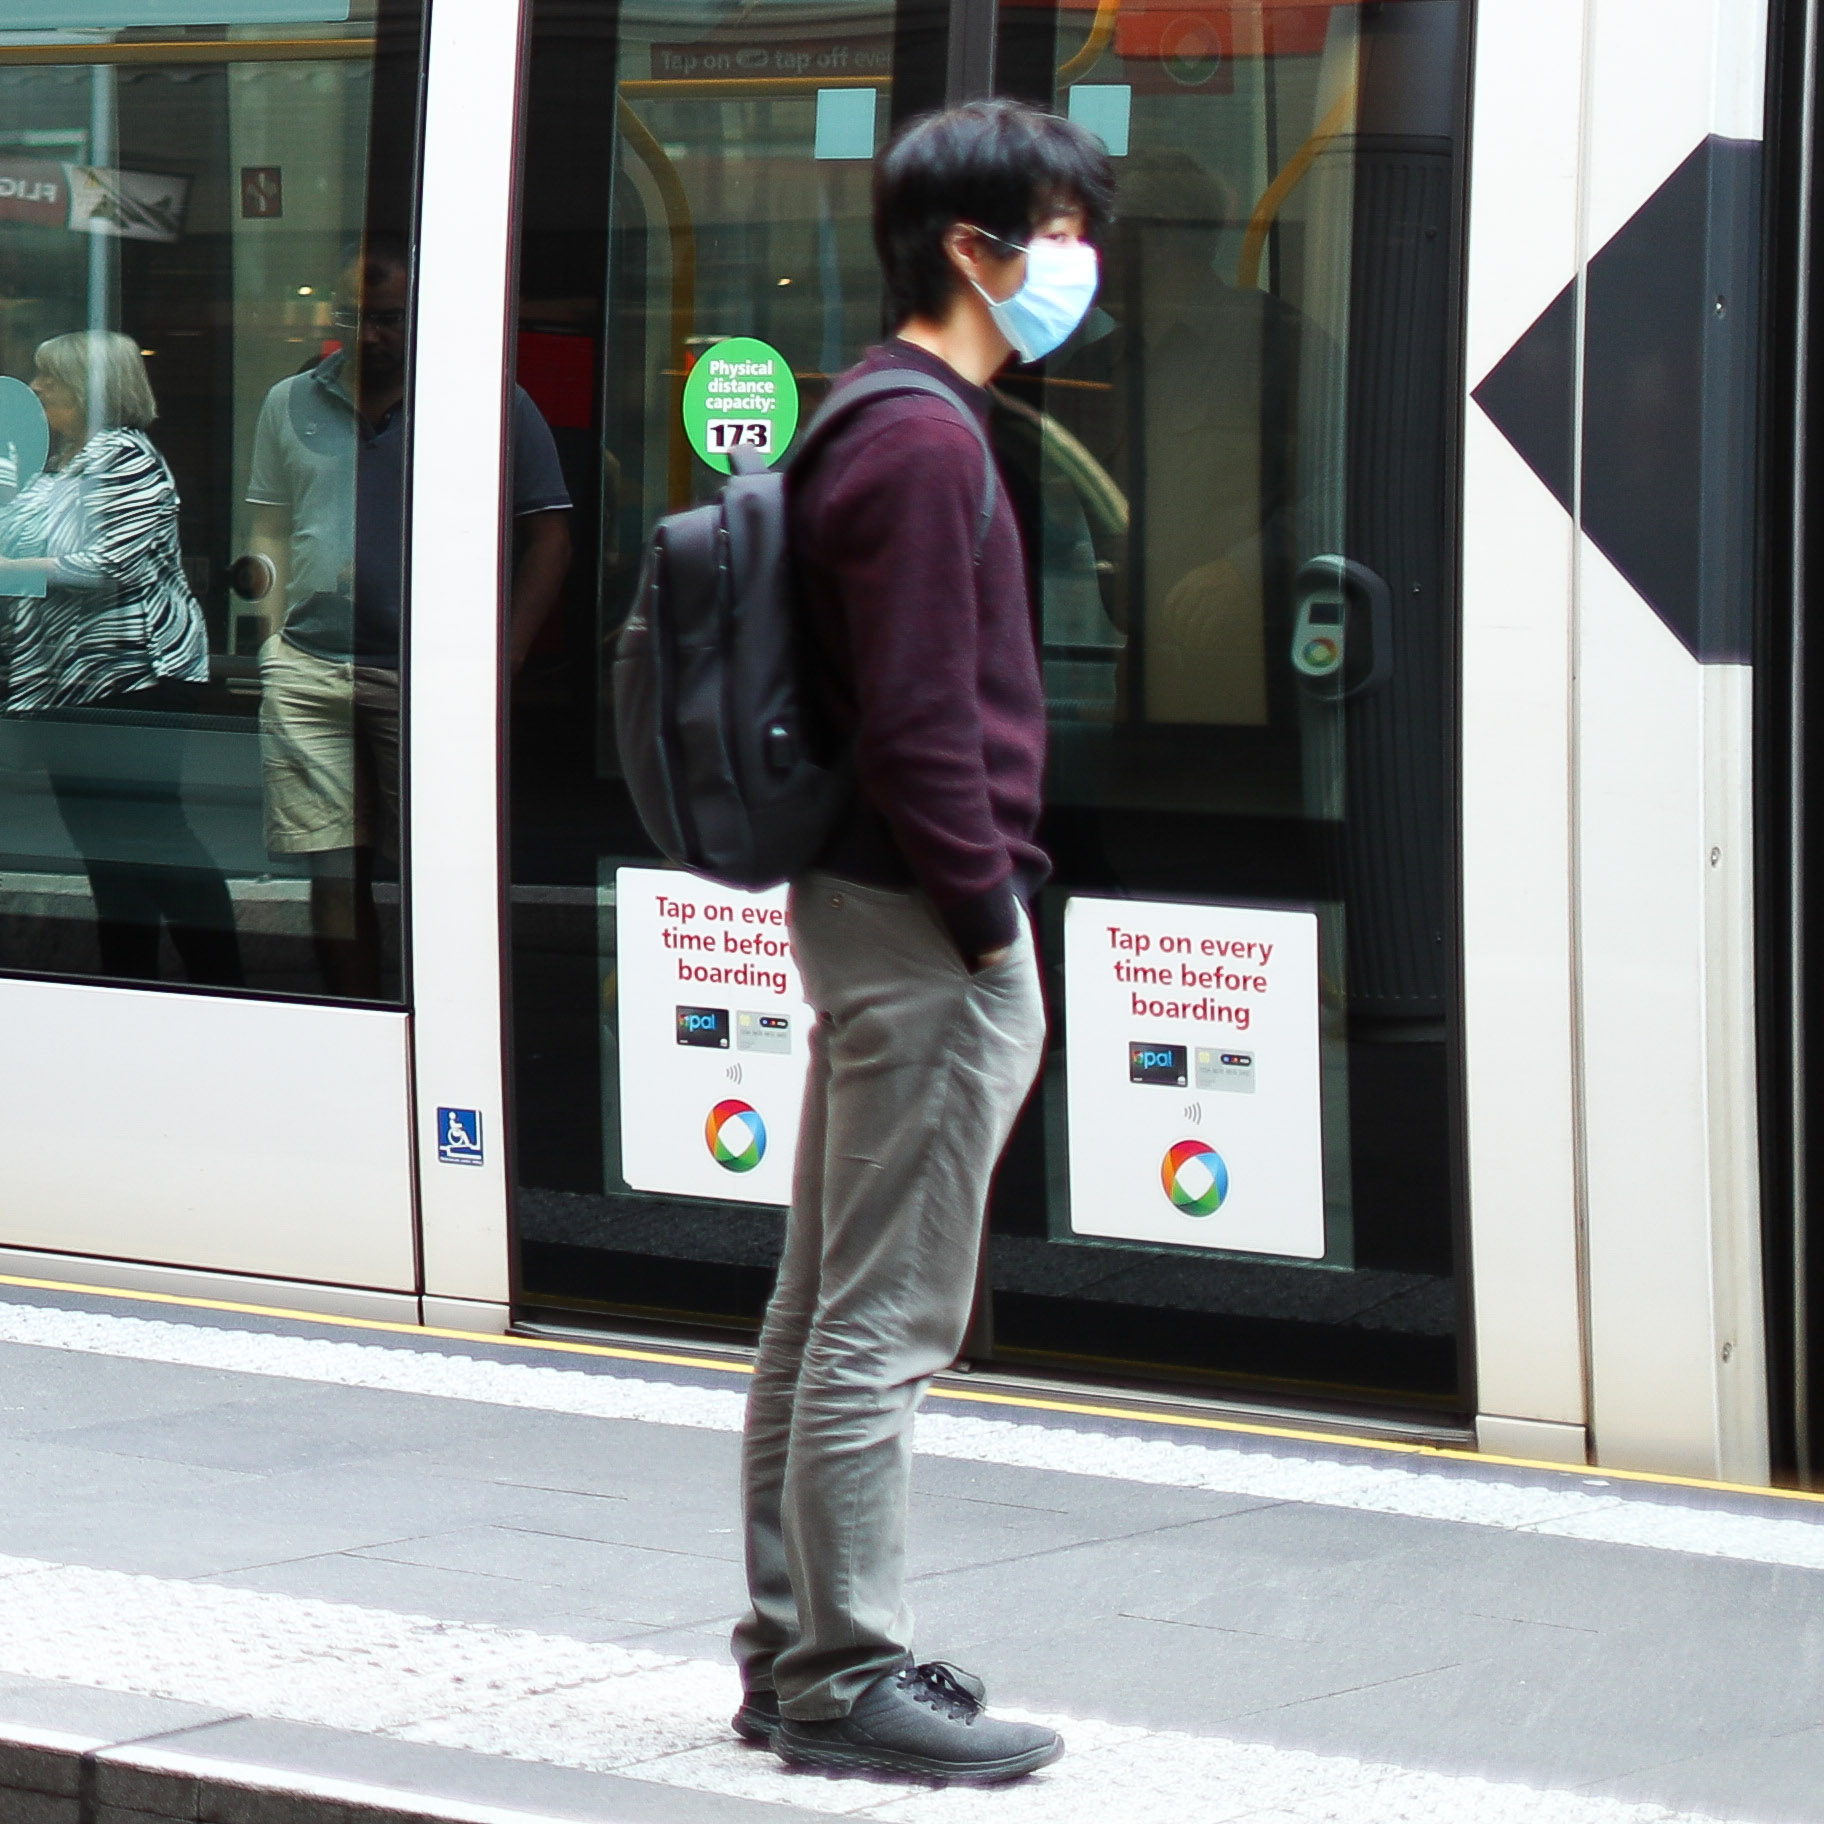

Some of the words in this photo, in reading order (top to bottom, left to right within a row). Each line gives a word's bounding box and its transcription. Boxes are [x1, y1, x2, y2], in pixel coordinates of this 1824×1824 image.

[661, 49, 697, 74] Tap
[703, 53, 730, 69] on
[775, 49, 809, 73] tap
[816, 45, 849, 68] off
[709, 359, 773, 379] Physical
[707, 377, 775, 394] distance
[705, 394, 776, 414] capacity:
[710, 423, 768, 448] 173
[656, 896, 696, 924] Tap
[703, 904, 734, 922] on
[741, 907, 788, 926] eve
[662, 927, 716, 952] time
[724, 930, 789, 957] befor
[1107, 927, 1151, 956] Tap
[1159, 936, 1192, 954] on
[1200, 939, 1273, 967] every
[678, 958, 787, 994] boarding
[1114, 959, 1173, 986] time
[1181, 963, 1267, 993] before
[1131, 992, 1251, 1031] boarding
